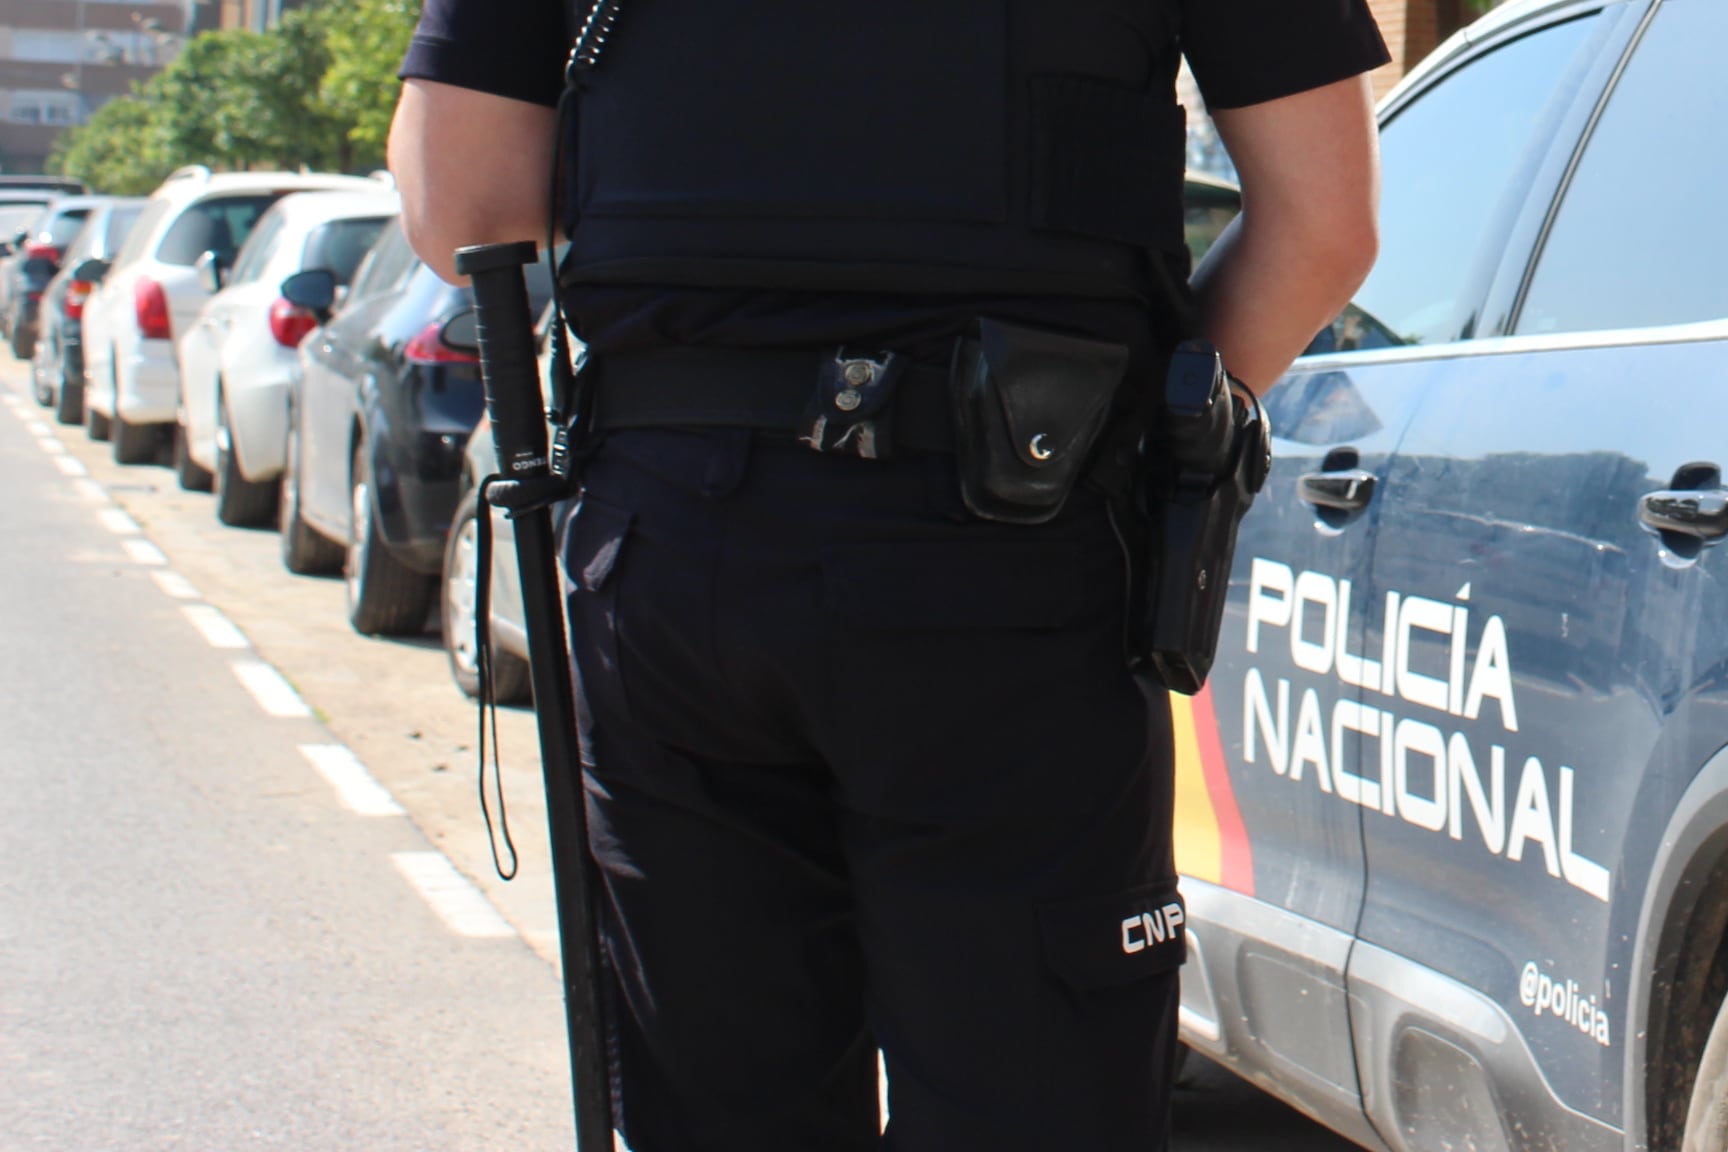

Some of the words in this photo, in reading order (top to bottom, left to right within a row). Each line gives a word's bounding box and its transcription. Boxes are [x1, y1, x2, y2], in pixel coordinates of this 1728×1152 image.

[1246, 557, 1519, 732] POLICÍA
[1243, 667, 1610, 902] NACIONAL
[1122, 903, 1184, 954] CNP
[1520, 960, 1610, 1047] @policia
